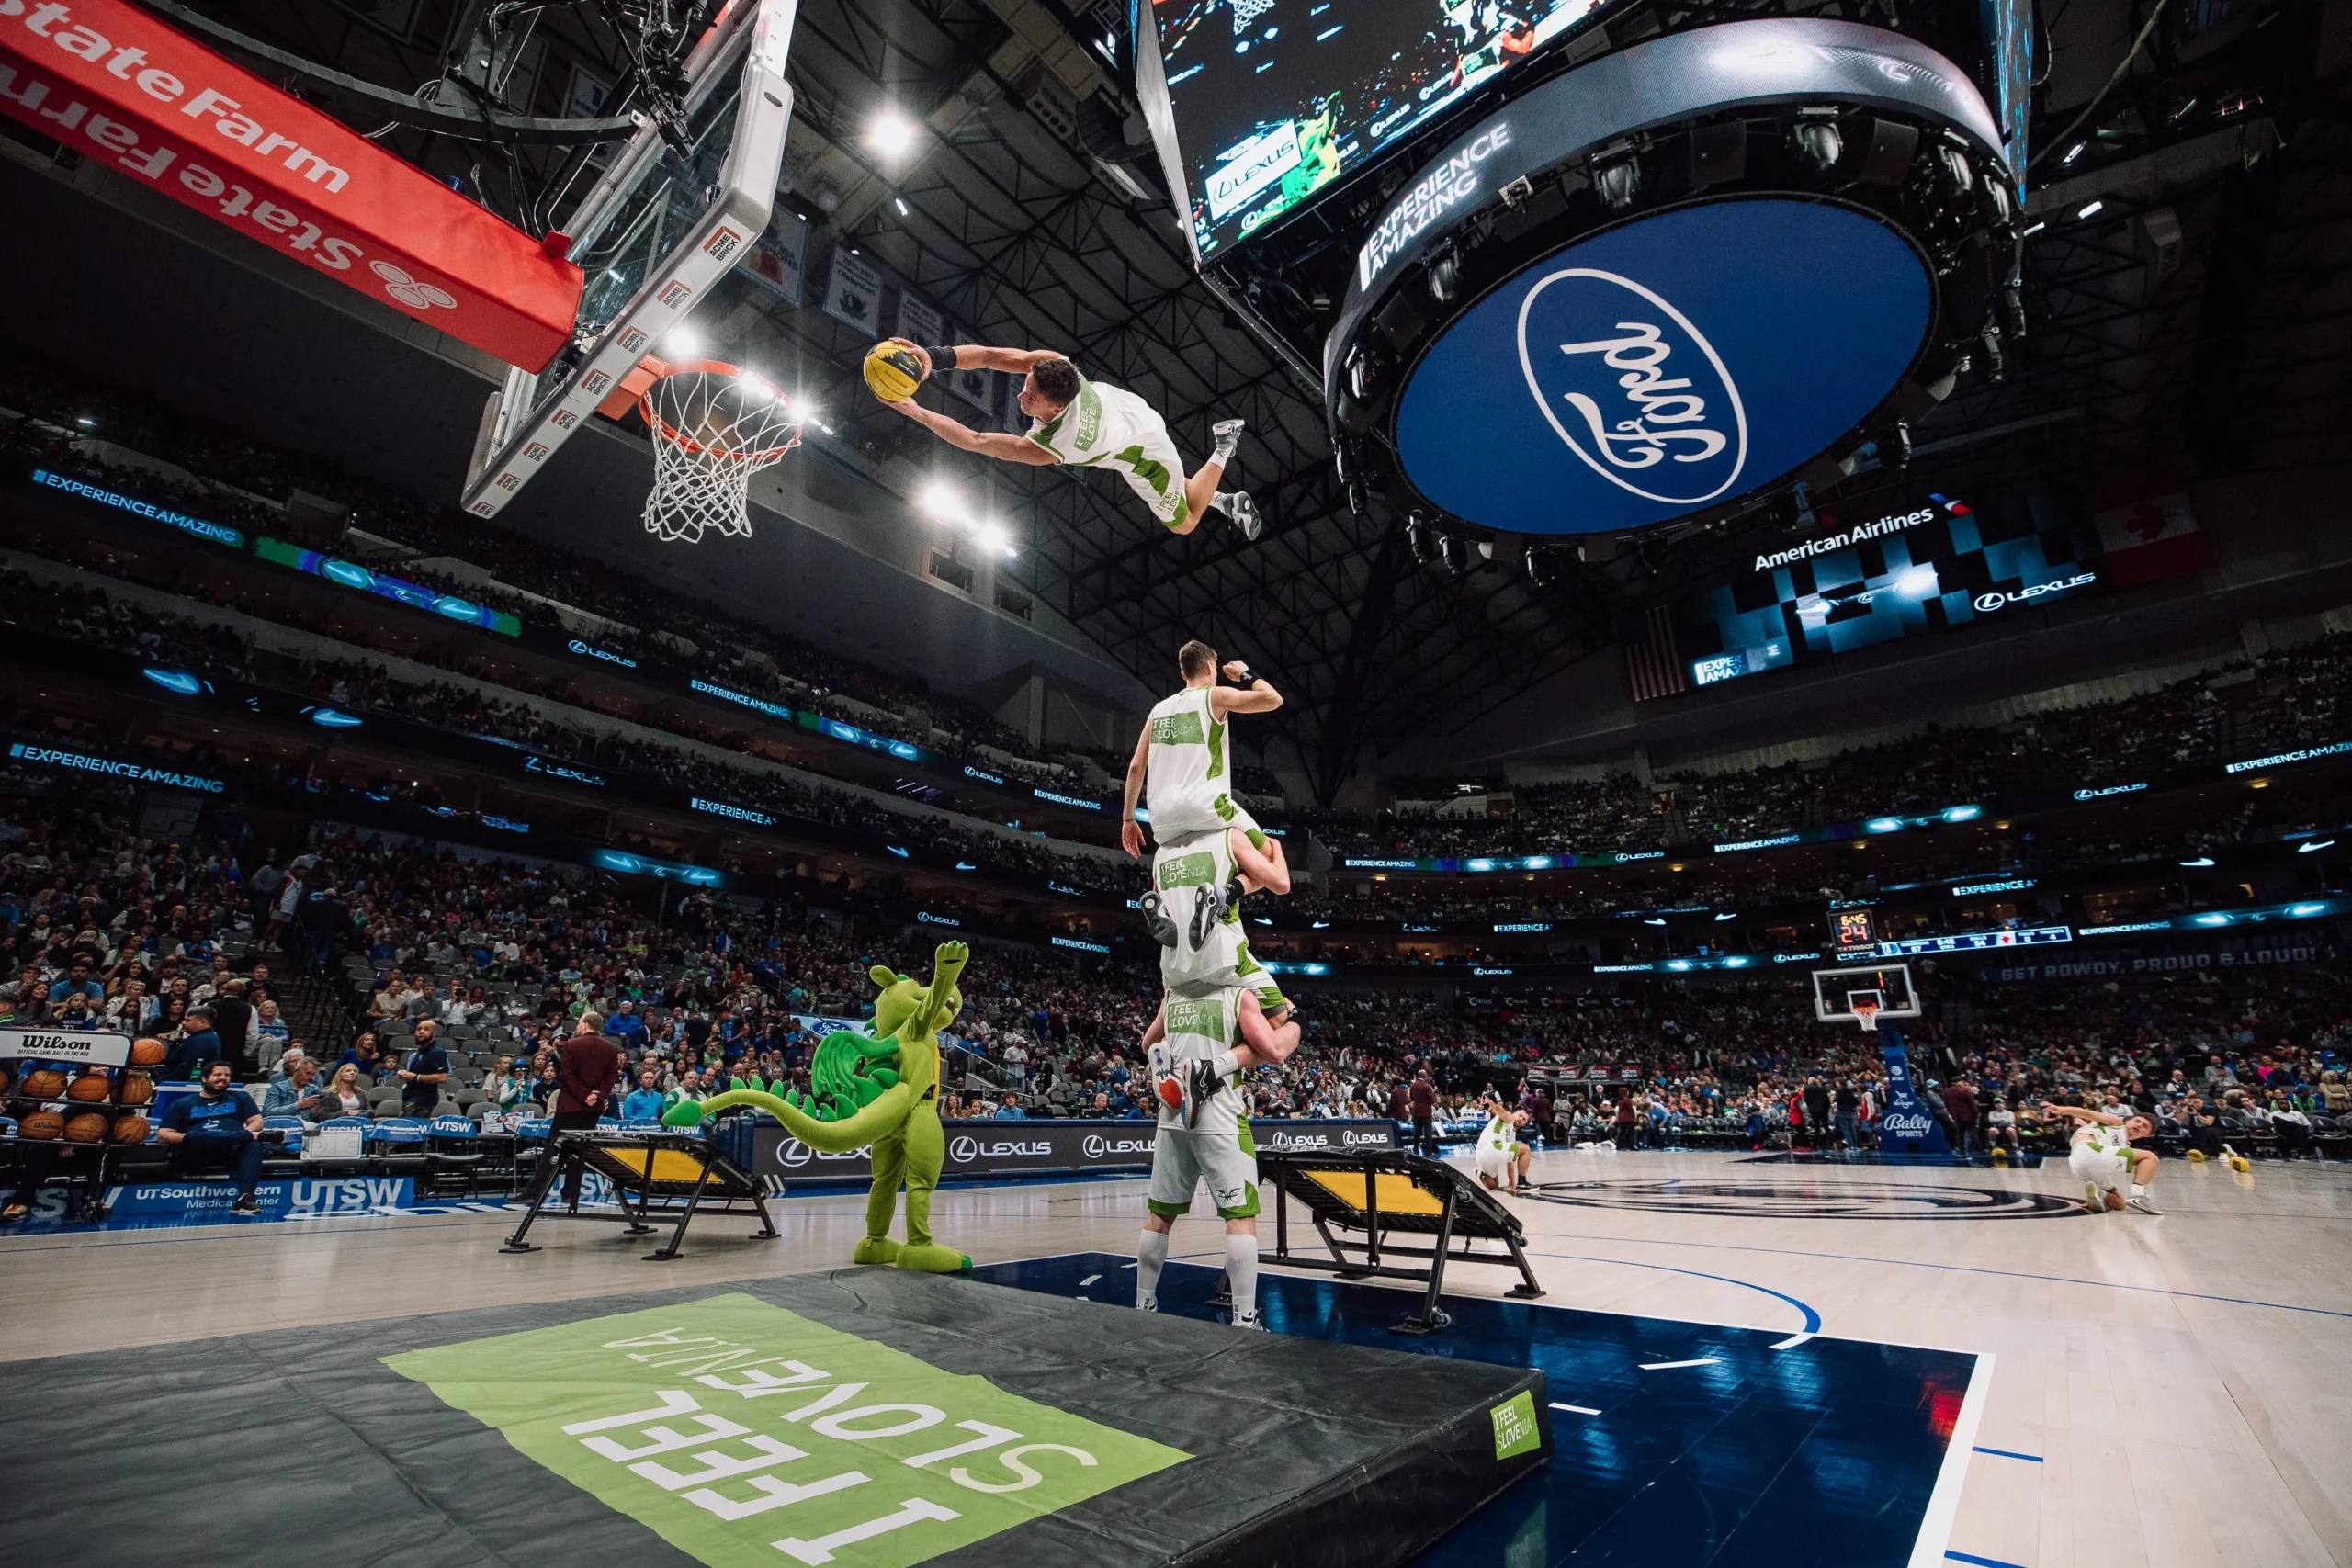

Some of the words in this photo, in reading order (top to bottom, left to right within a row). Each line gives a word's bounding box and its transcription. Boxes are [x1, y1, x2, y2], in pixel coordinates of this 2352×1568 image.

[181, 87, 350, 195] Farm
[1234, 140, 1294, 186] LEXUS
[1369, 122, 1510, 256] EXPERIENCE
[179, 164, 365, 270] State
[1372, 170, 1477, 280] AMAZING
[709, 232, 731, 256] ACME
[715, 238, 739, 262] BRICK
[663, 287, 683, 306] ACME
[669, 290, 690, 310] BRICK
[623, 331, 639, 351] ACME
[628, 334, 647, 353] BRICK
[586, 373, 604, 393] ACME
[594, 377, 610, 396] BRICK
[1560, 321, 1726, 469] Ford
[1079, 408, 1089, 438] FEEL
[46, 473, 156, 517] EXPERIENCE
[155, 511, 237, 543] AMAZING
[1160, 491, 1174, 508] FEEL
[1755, 533, 1849, 571] American
[1851, 508, 1934, 543] Airlines
[2006, 571, 2096, 603] LEXUS
[587, 647, 637, 668] LEXUS
[698, 682, 750, 705] EXPERIENCE
[749, 699, 789, 717] AMAZING
[24, 746, 141, 777] EXPERIENCE
[140, 769, 224, 794] AMAZING
[2234, 750, 2307, 772] EXPERIENCE
[976, 772, 1003, 784] LEXUS
[2094, 782, 2148, 796] LEXUS
[1037, 790, 1073, 805] EXPERIENCE
[1072, 797, 1101, 810] AMAZING
[698, 799, 763, 824] EXPERIENCE
[1721, 840, 1764, 851] EXPERIENCE
[1763, 835, 1800, 846] AMAZING
[1350, 859, 1386, 867] EXPERIENCE
[1628, 851, 1665, 860] LEXUS
[1958, 880, 2025, 895] EXPERIENCE
[930, 915, 960, 927] LEXUS
[1498, 923, 1544, 932] EXPERIENCE
[1056, 938, 1087, 950] EXPERIENCE
[1840, 925, 1868, 943] 24
[1786, 953, 1820, 961] LEXUS
[2002, 964, 2037, 981] GET
[2133, 953, 2210, 972] PROUD
[1599, 964, 1629, 972] EXPERIENCE
[1174, 1002, 1196, 1015] FEEL
[22, 1034, 91, 1050] Wilson
[435, 1120, 471, 1132] UTSW
[673, 1125, 700, 1134] UTSW
[1883, 1113, 1932, 1134] Bally
[979, 1141, 1051, 1156] LEXUS
[1288, 1134, 1328, 1145] LEXUS
[1355, 1133, 1388, 1144] LEXUS
[290, 1179, 404, 1206] UTSW
[187, 1198, 237, 1208] Medica
[601, 1326, 1099, 1494] SLOVENIA
[1494, 1414, 1499, 1431] I
[1498, 1404, 1518, 1427] FEEL
[1497, 1416, 1532, 1452] SLOVENIA
[561, 1389, 873, 1522] FEEL
[769, 1497, 963, 1567] I
